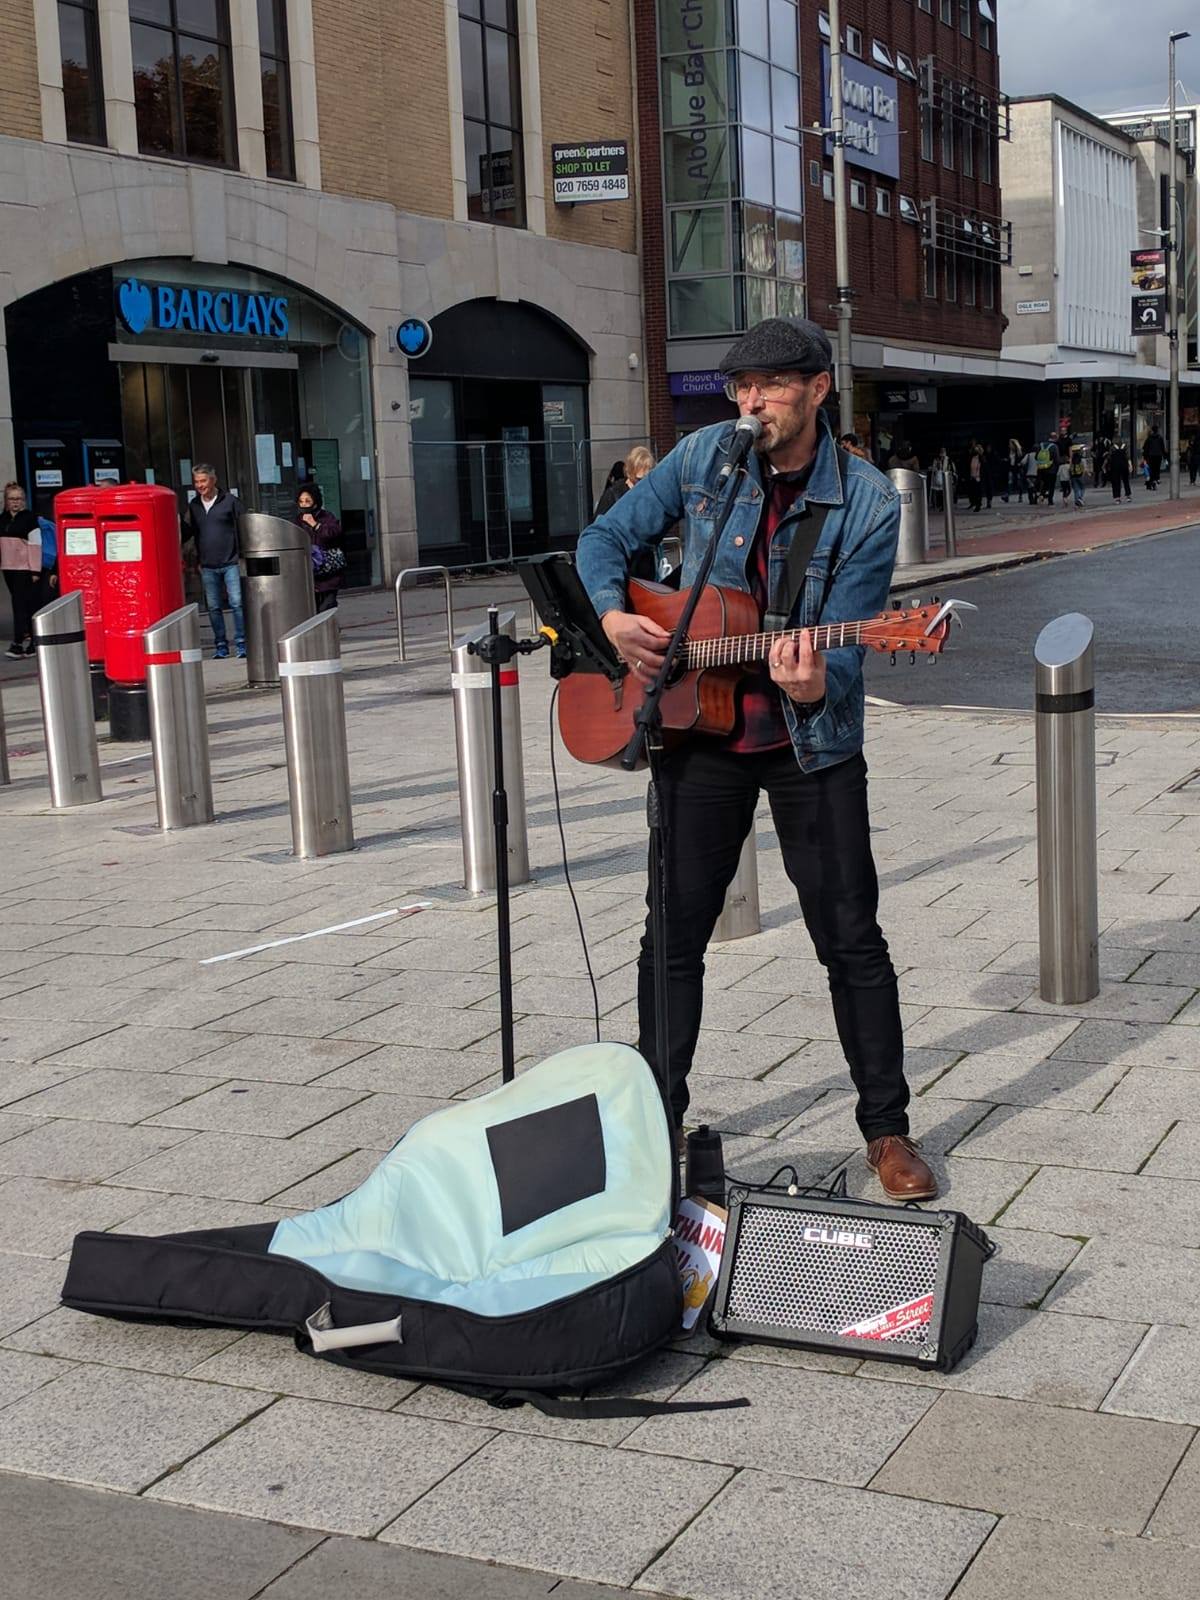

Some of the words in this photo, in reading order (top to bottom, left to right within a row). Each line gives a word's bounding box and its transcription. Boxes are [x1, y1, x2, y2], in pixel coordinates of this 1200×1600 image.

[684, 40, 705, 87] Bar
[687, 95, 709, 180] Above
[554, 146, 625, 161] green&partners
[556, 163, 580, 174] SHOP
[581, 162, 593, 173] TO
[594, 161, 611, 172] LET
[556, 182, 574, 193] 020
[576, 180, 600, 192] 7659
[601, 178, 626, 190] 4848
[158, 286, 288, 338] BARCLAYS
[682, 373, 713, 383] Above
[682, 382, 716, 392] Church
[803, 1227, 873, 1249] CUBE
[896, 1302, 929, 1325] Street
